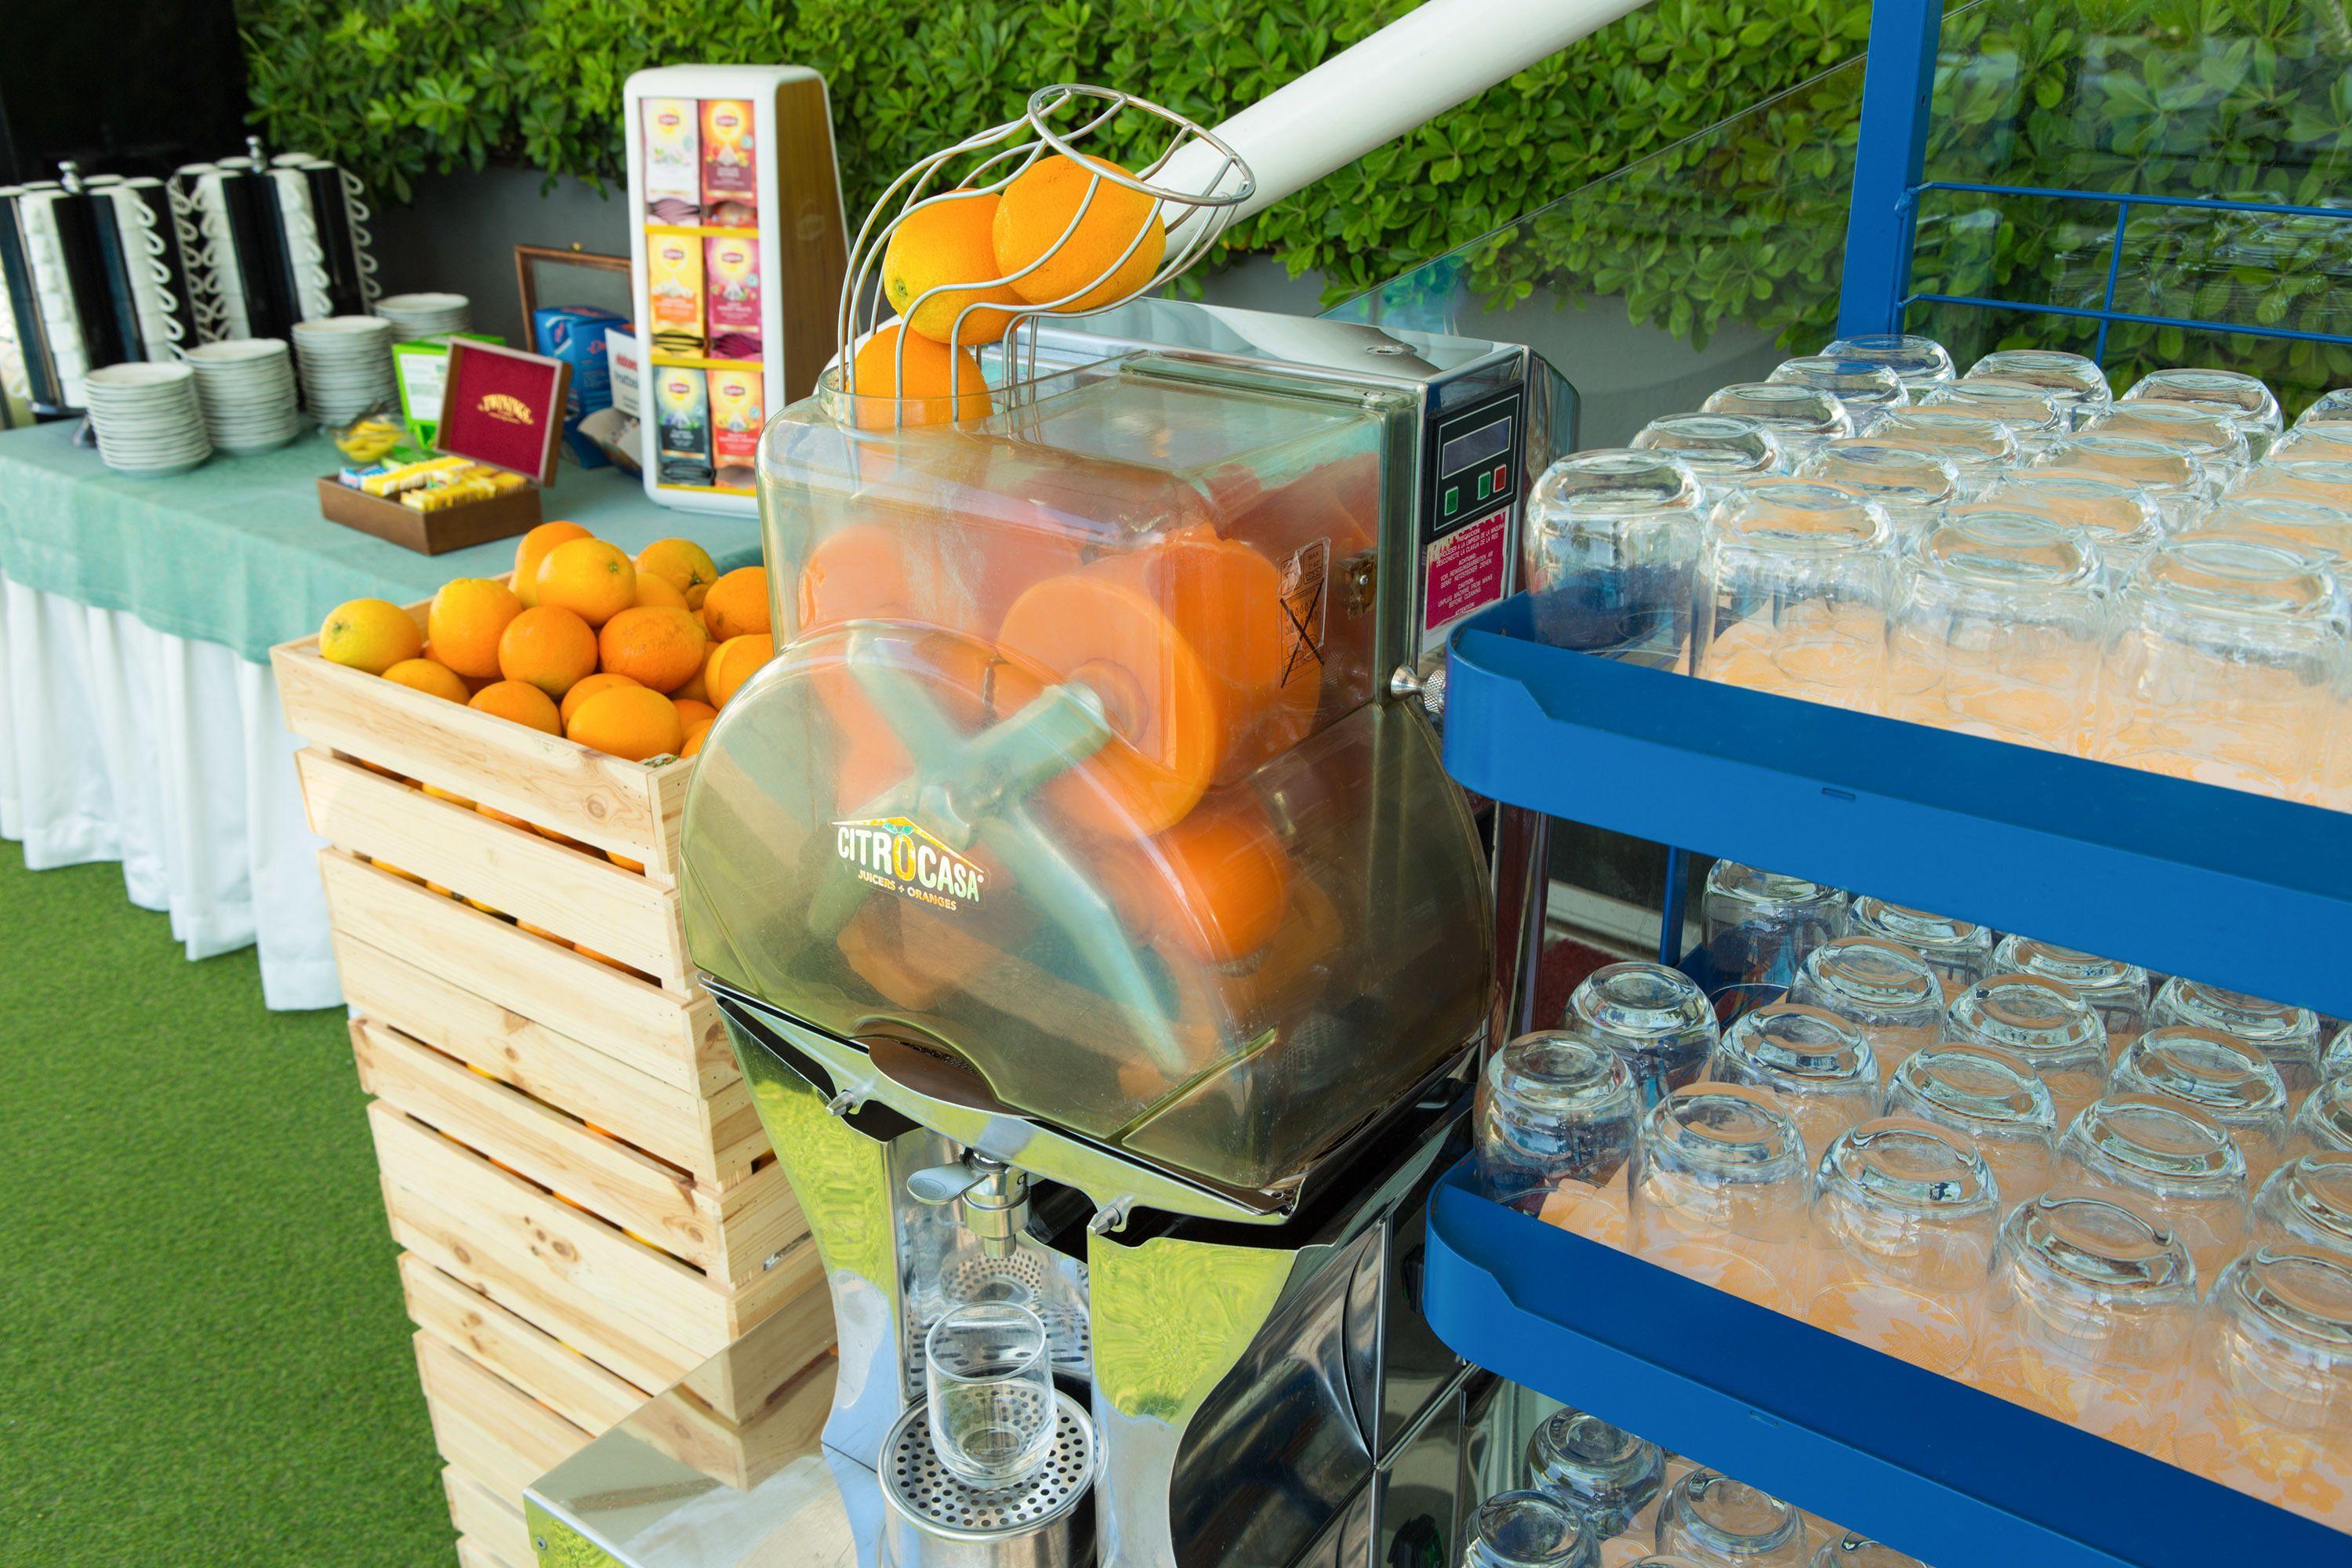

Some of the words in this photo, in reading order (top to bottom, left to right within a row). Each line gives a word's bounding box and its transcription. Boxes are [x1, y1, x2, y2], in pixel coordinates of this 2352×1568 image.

[837, 826, 979, 902] CITROCASA
[858, 869, 896, 891] JUICERS
[907, 886, 957, 911] ORANGES
